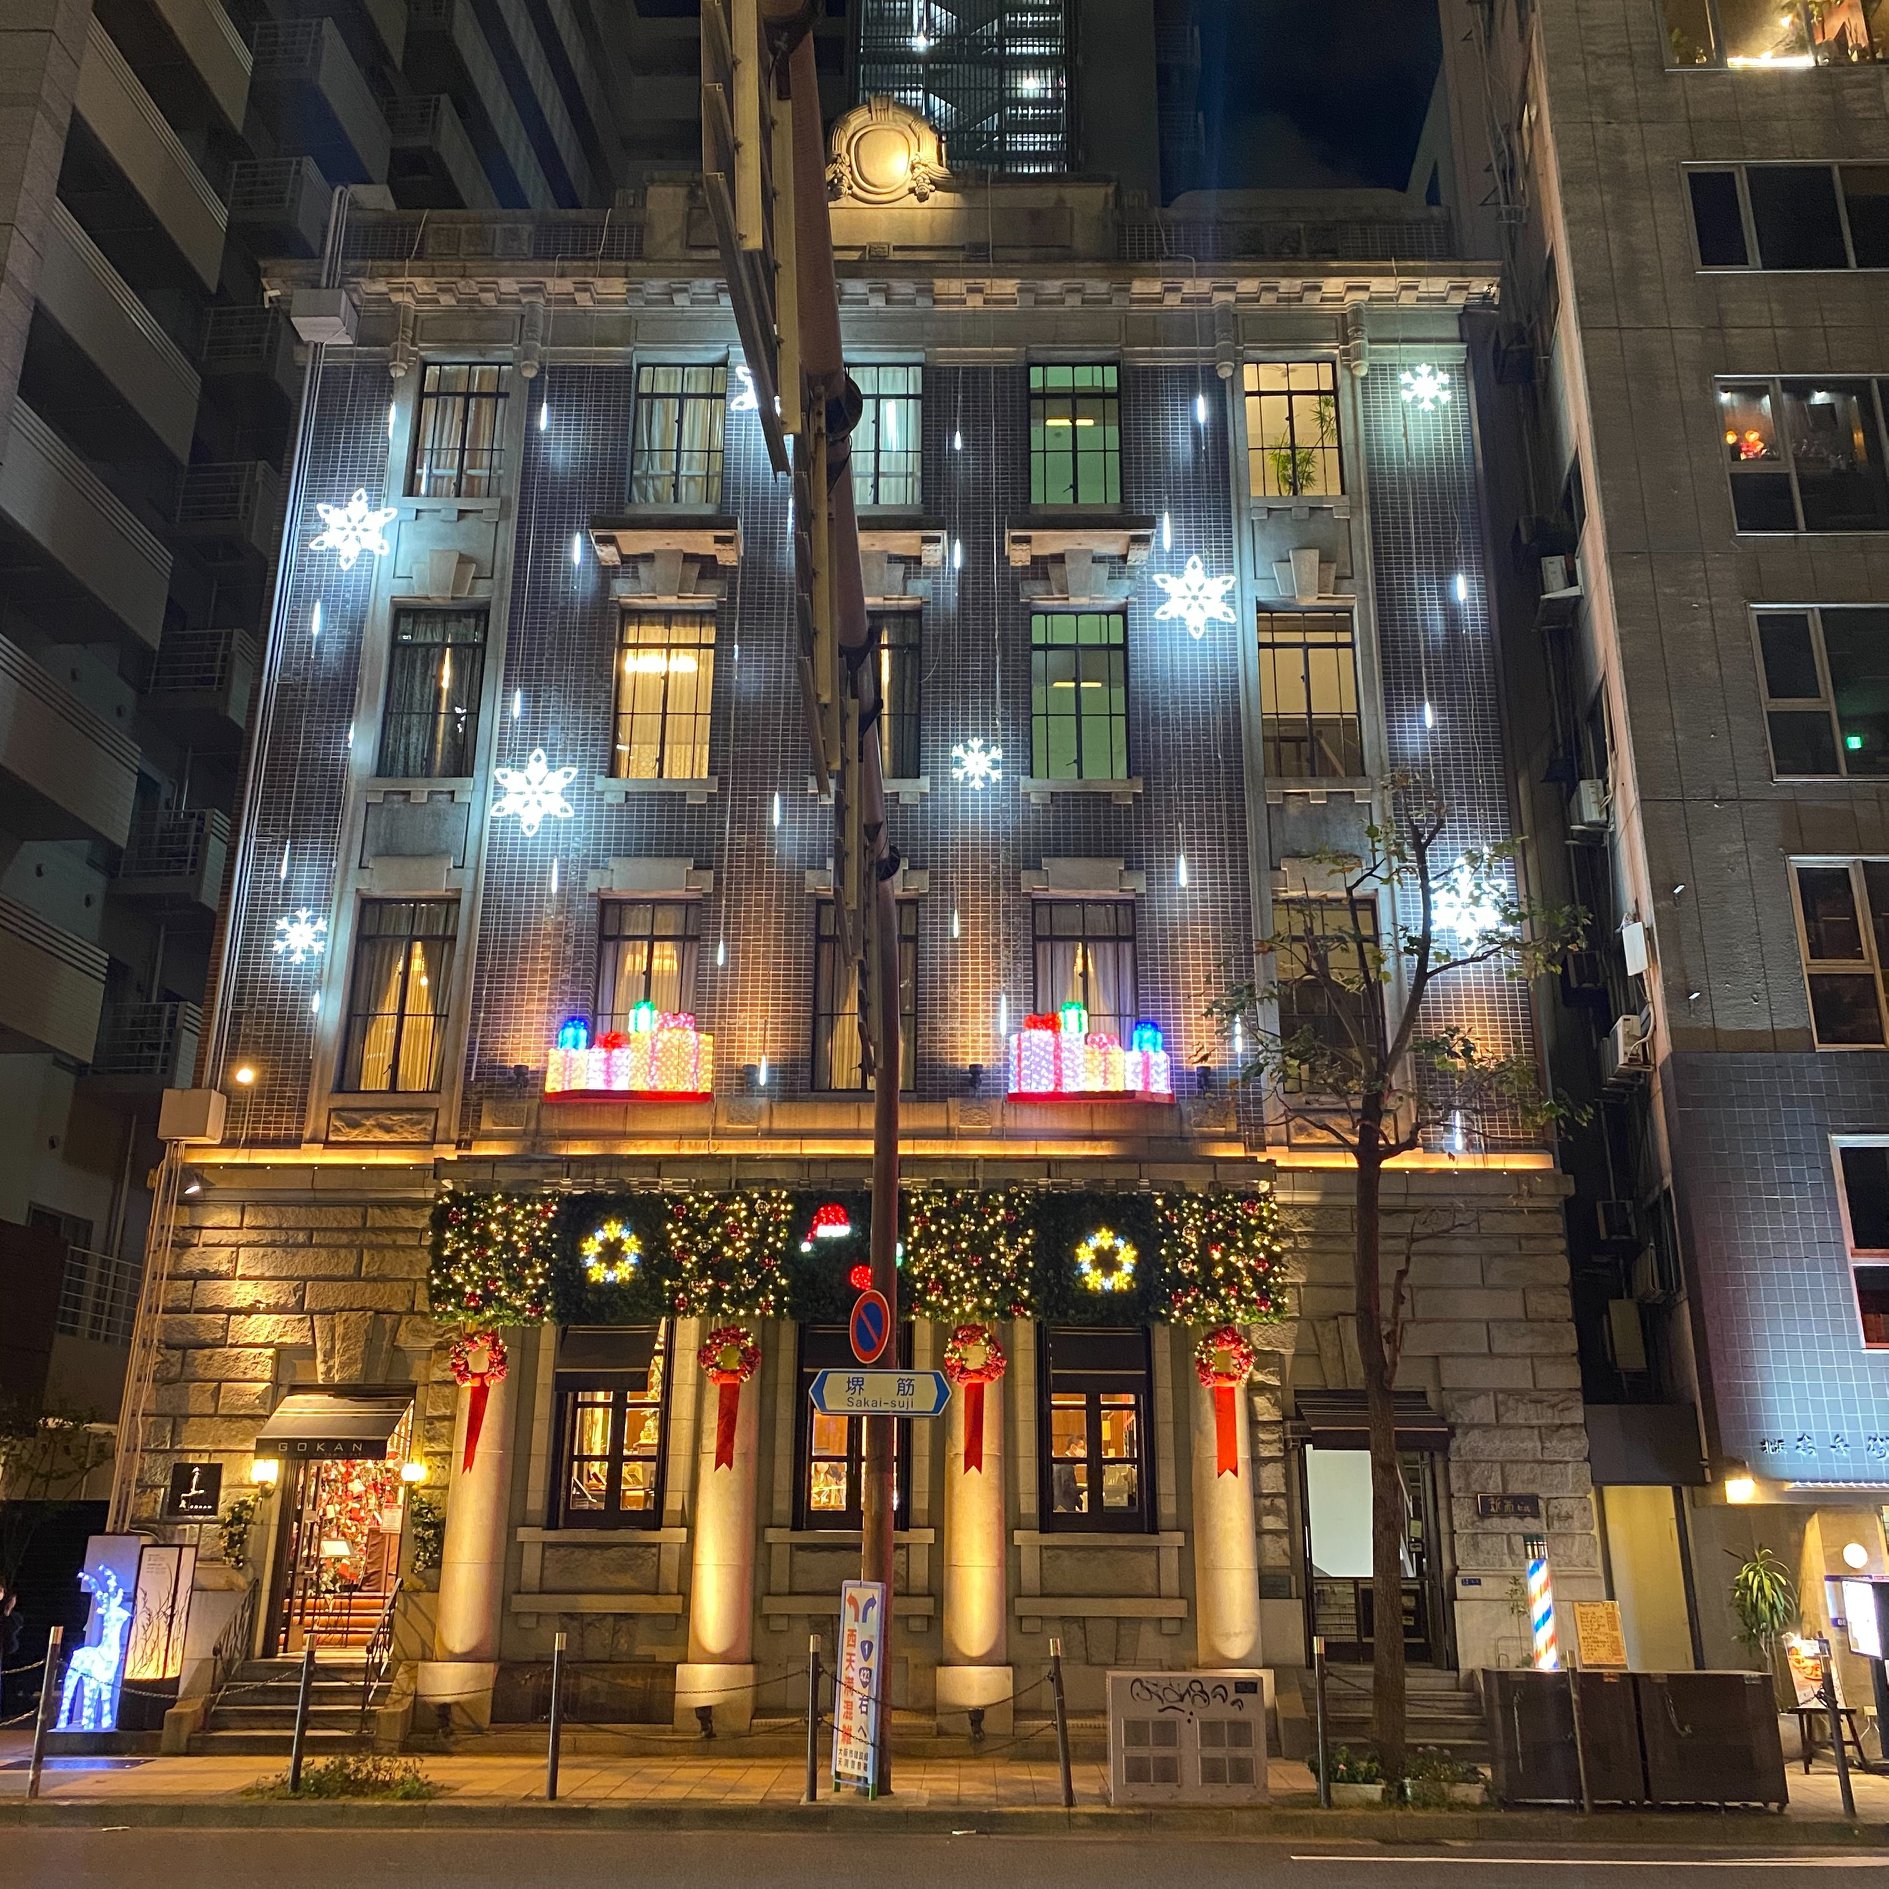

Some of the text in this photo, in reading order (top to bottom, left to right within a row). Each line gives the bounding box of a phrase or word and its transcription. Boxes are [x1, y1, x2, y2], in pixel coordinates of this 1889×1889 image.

[845, 1376, 915, 1396] 堺筋
[847, 1397, 914, 1410] Sakai-suji
[279, 1442, 362, 1452] GOKAN
